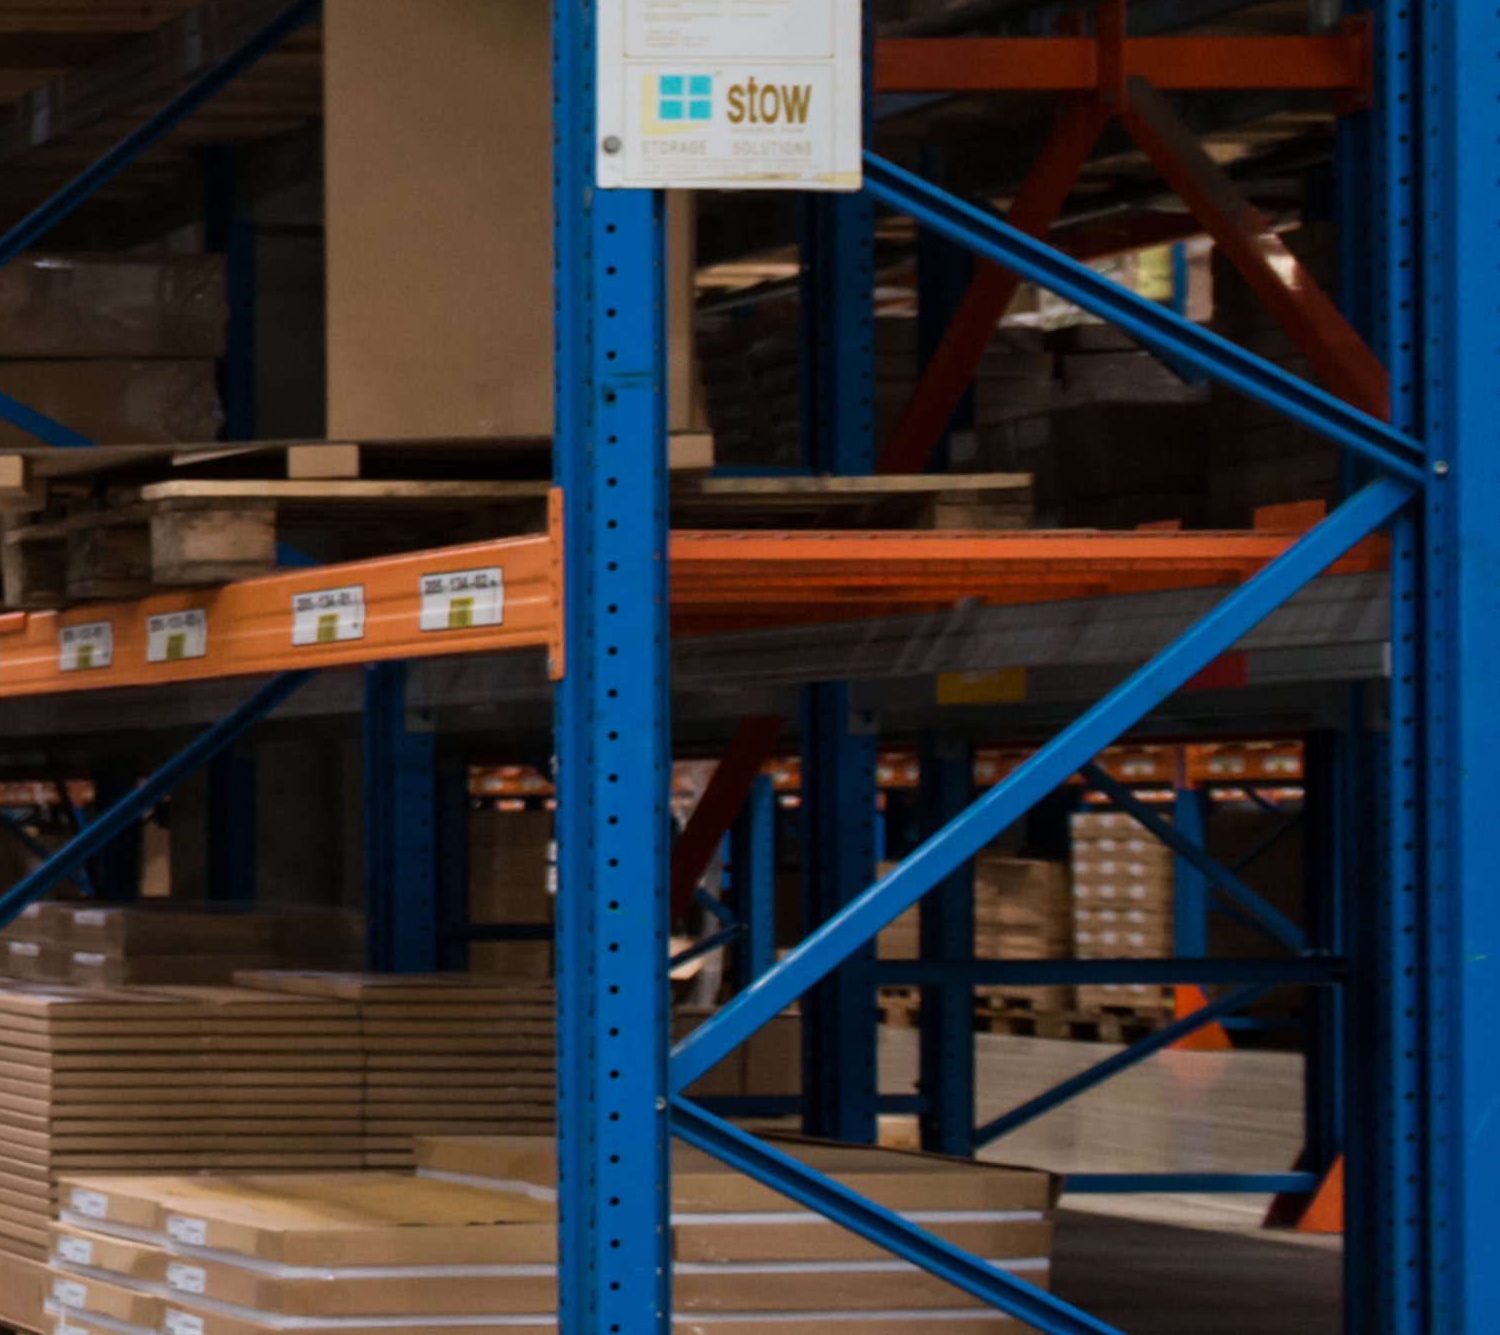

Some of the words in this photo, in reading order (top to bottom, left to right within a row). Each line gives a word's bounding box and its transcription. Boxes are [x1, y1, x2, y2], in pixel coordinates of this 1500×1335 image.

[727, 76, 812, 124] stow
[642, 140, 707, 156] STORAGE
[733, 140, 813, 156] SOLUTIONS
